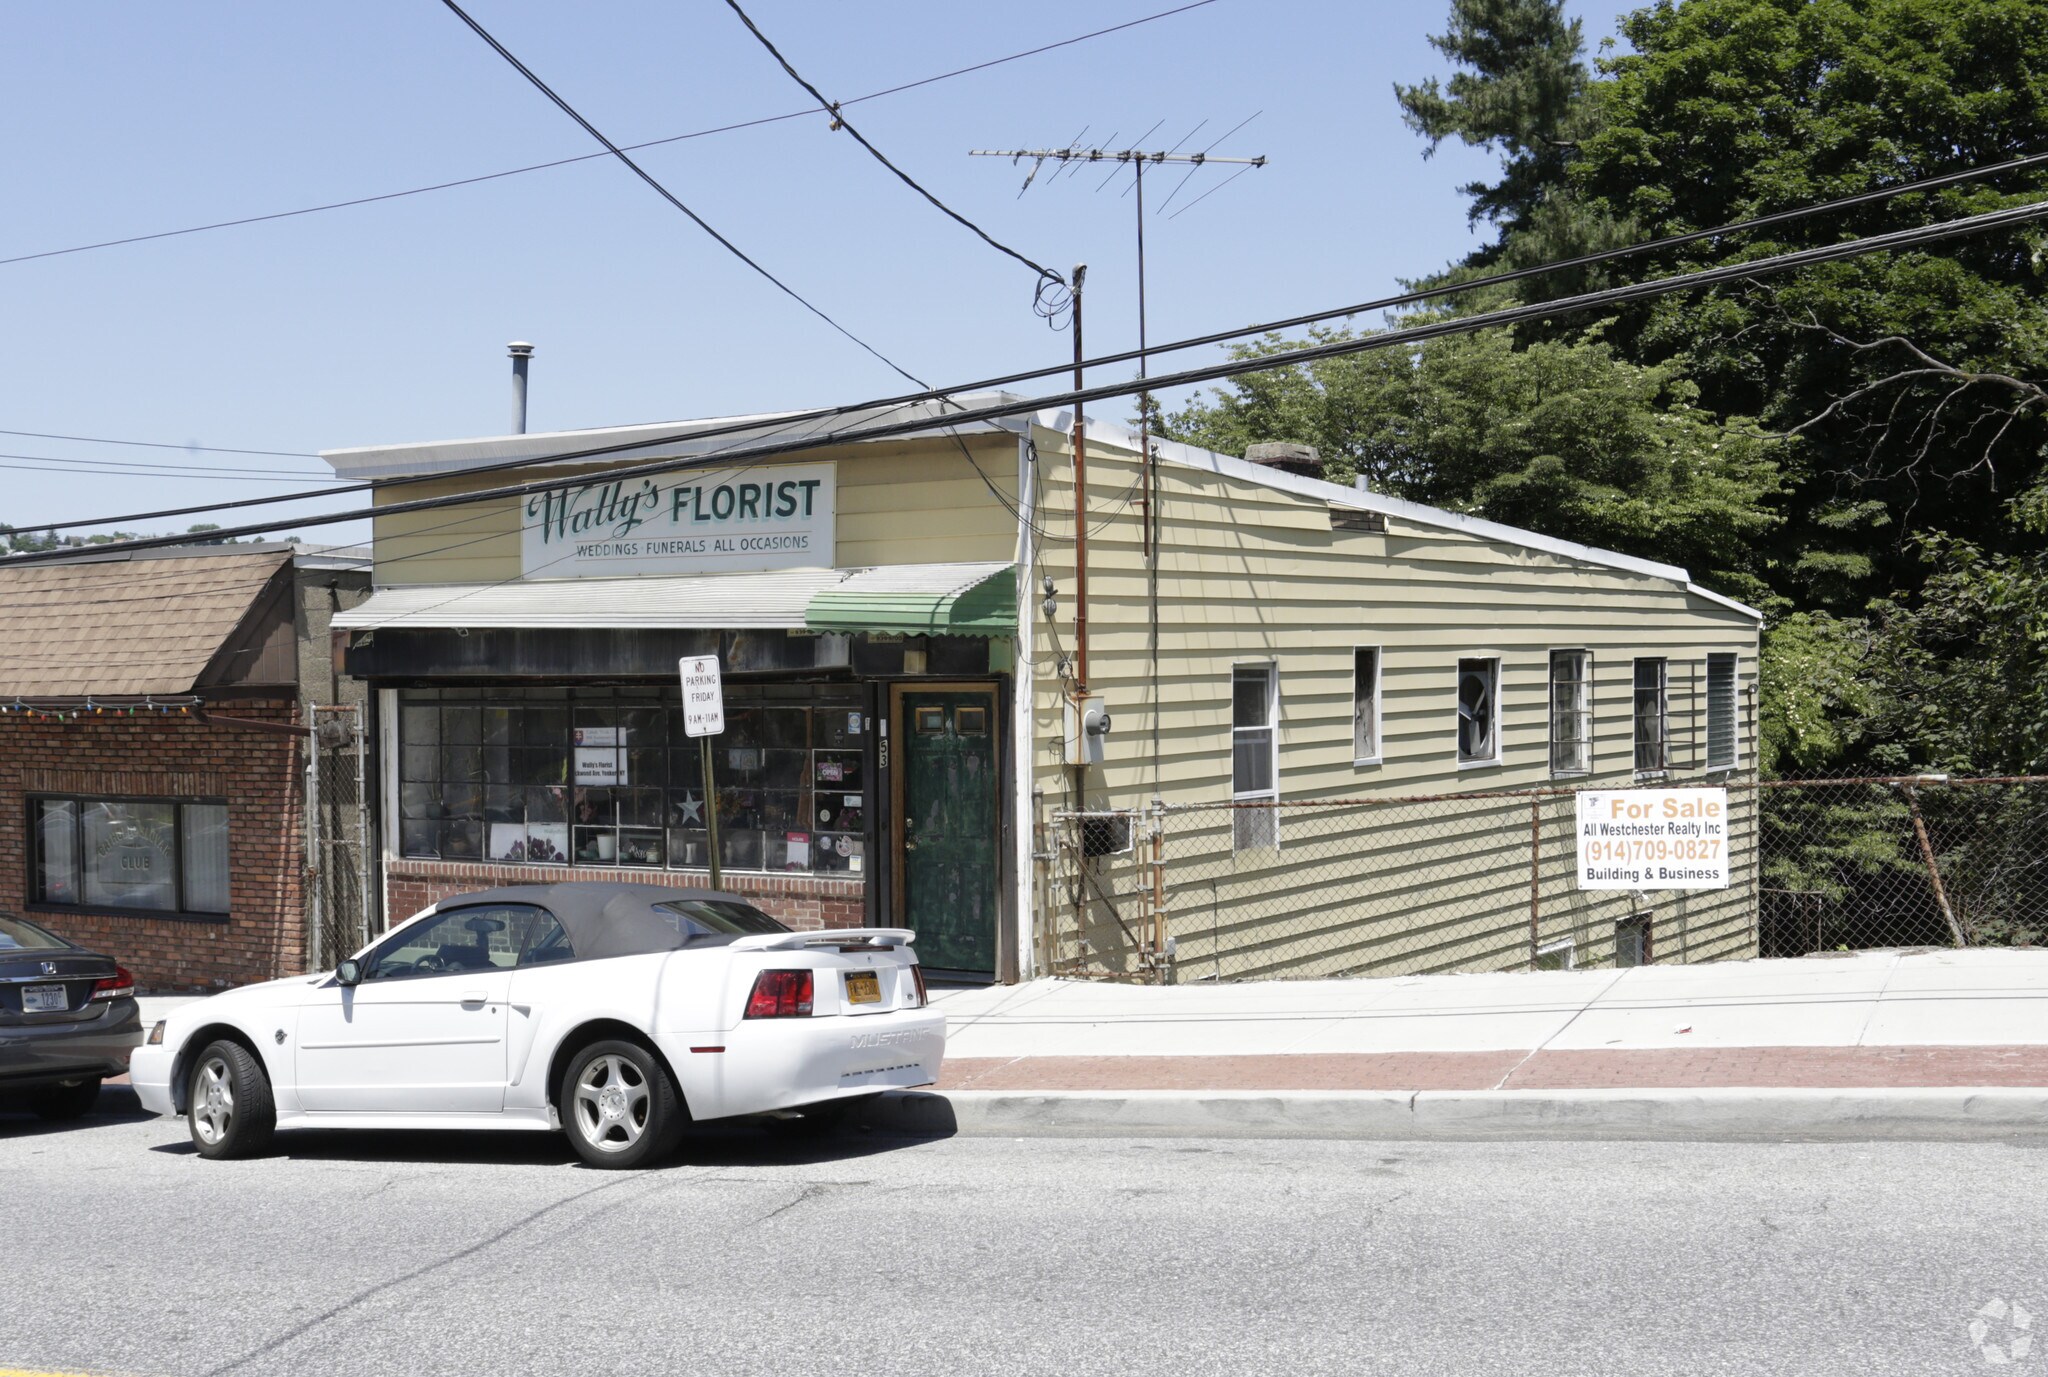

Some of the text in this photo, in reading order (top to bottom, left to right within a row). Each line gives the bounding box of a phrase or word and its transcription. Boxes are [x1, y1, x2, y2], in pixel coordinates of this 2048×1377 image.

[528, 479, 821, 545] Wally's FLORIST
[576, 535, 809, 557] WEDDINGS FUNERALS ALL OCCASIONS
[694, 662, 705, 673] NO
[686, 674, 717, 687] PARKING
[691, 692, 715, 703] FRIDAY
[880, 741, 887, 767] 53
[582, 761, 598, 769] Wally's
[822, 769, 839, 777] OPEN
[1611, 798, 1721, 819] For Sale
[1583, 821, 1721, 838] All Westchester Realty Inc
[1585, 839, 1721, 866] (914)709-0827
[121, 856, 150, 870] CLUB
[1587, 867, 1720, 882] Building & Business
